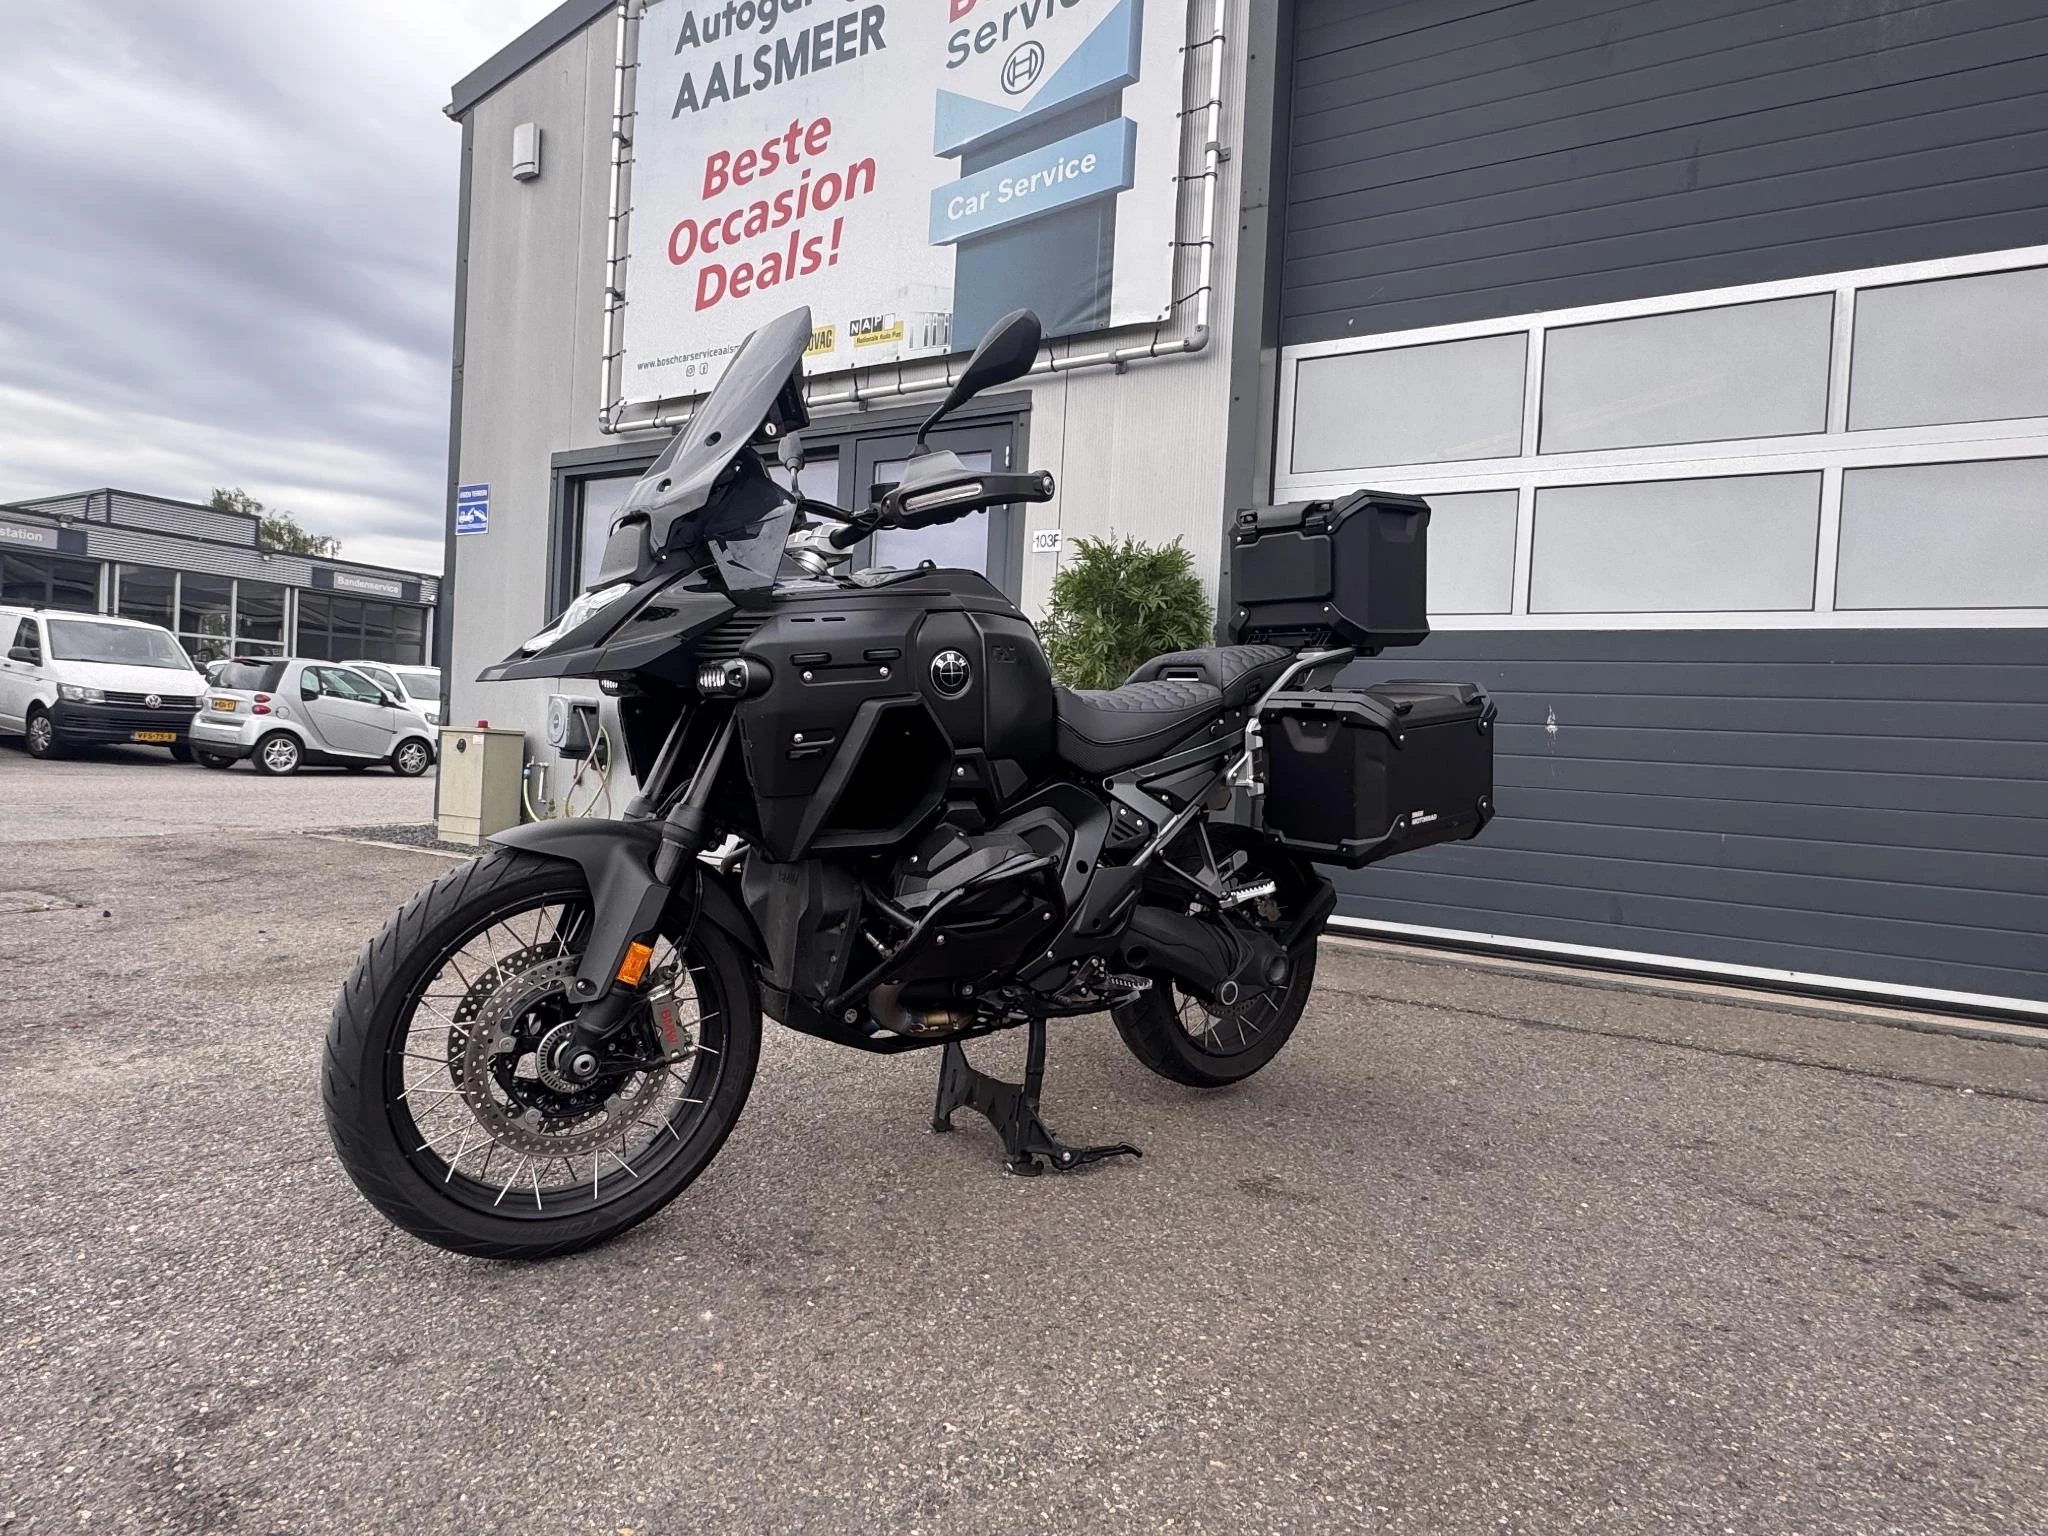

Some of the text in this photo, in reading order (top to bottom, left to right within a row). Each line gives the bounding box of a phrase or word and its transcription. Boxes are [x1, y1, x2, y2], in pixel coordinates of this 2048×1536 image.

[671, 4, 887, 119] AALSMEER
[702, 117, 832, 200] Beste
[947, 152, 1096, 221] Car Service
[667, 157, 876, 266] Occasion
[694, 217, 844, 312] Deals!
[808, 330, 833, 351] OVAG
[850, 315, 883, 335] NAP
[1035, 533, 1060, 549] 103F
[660, 1009, 678, 1044] BMW
